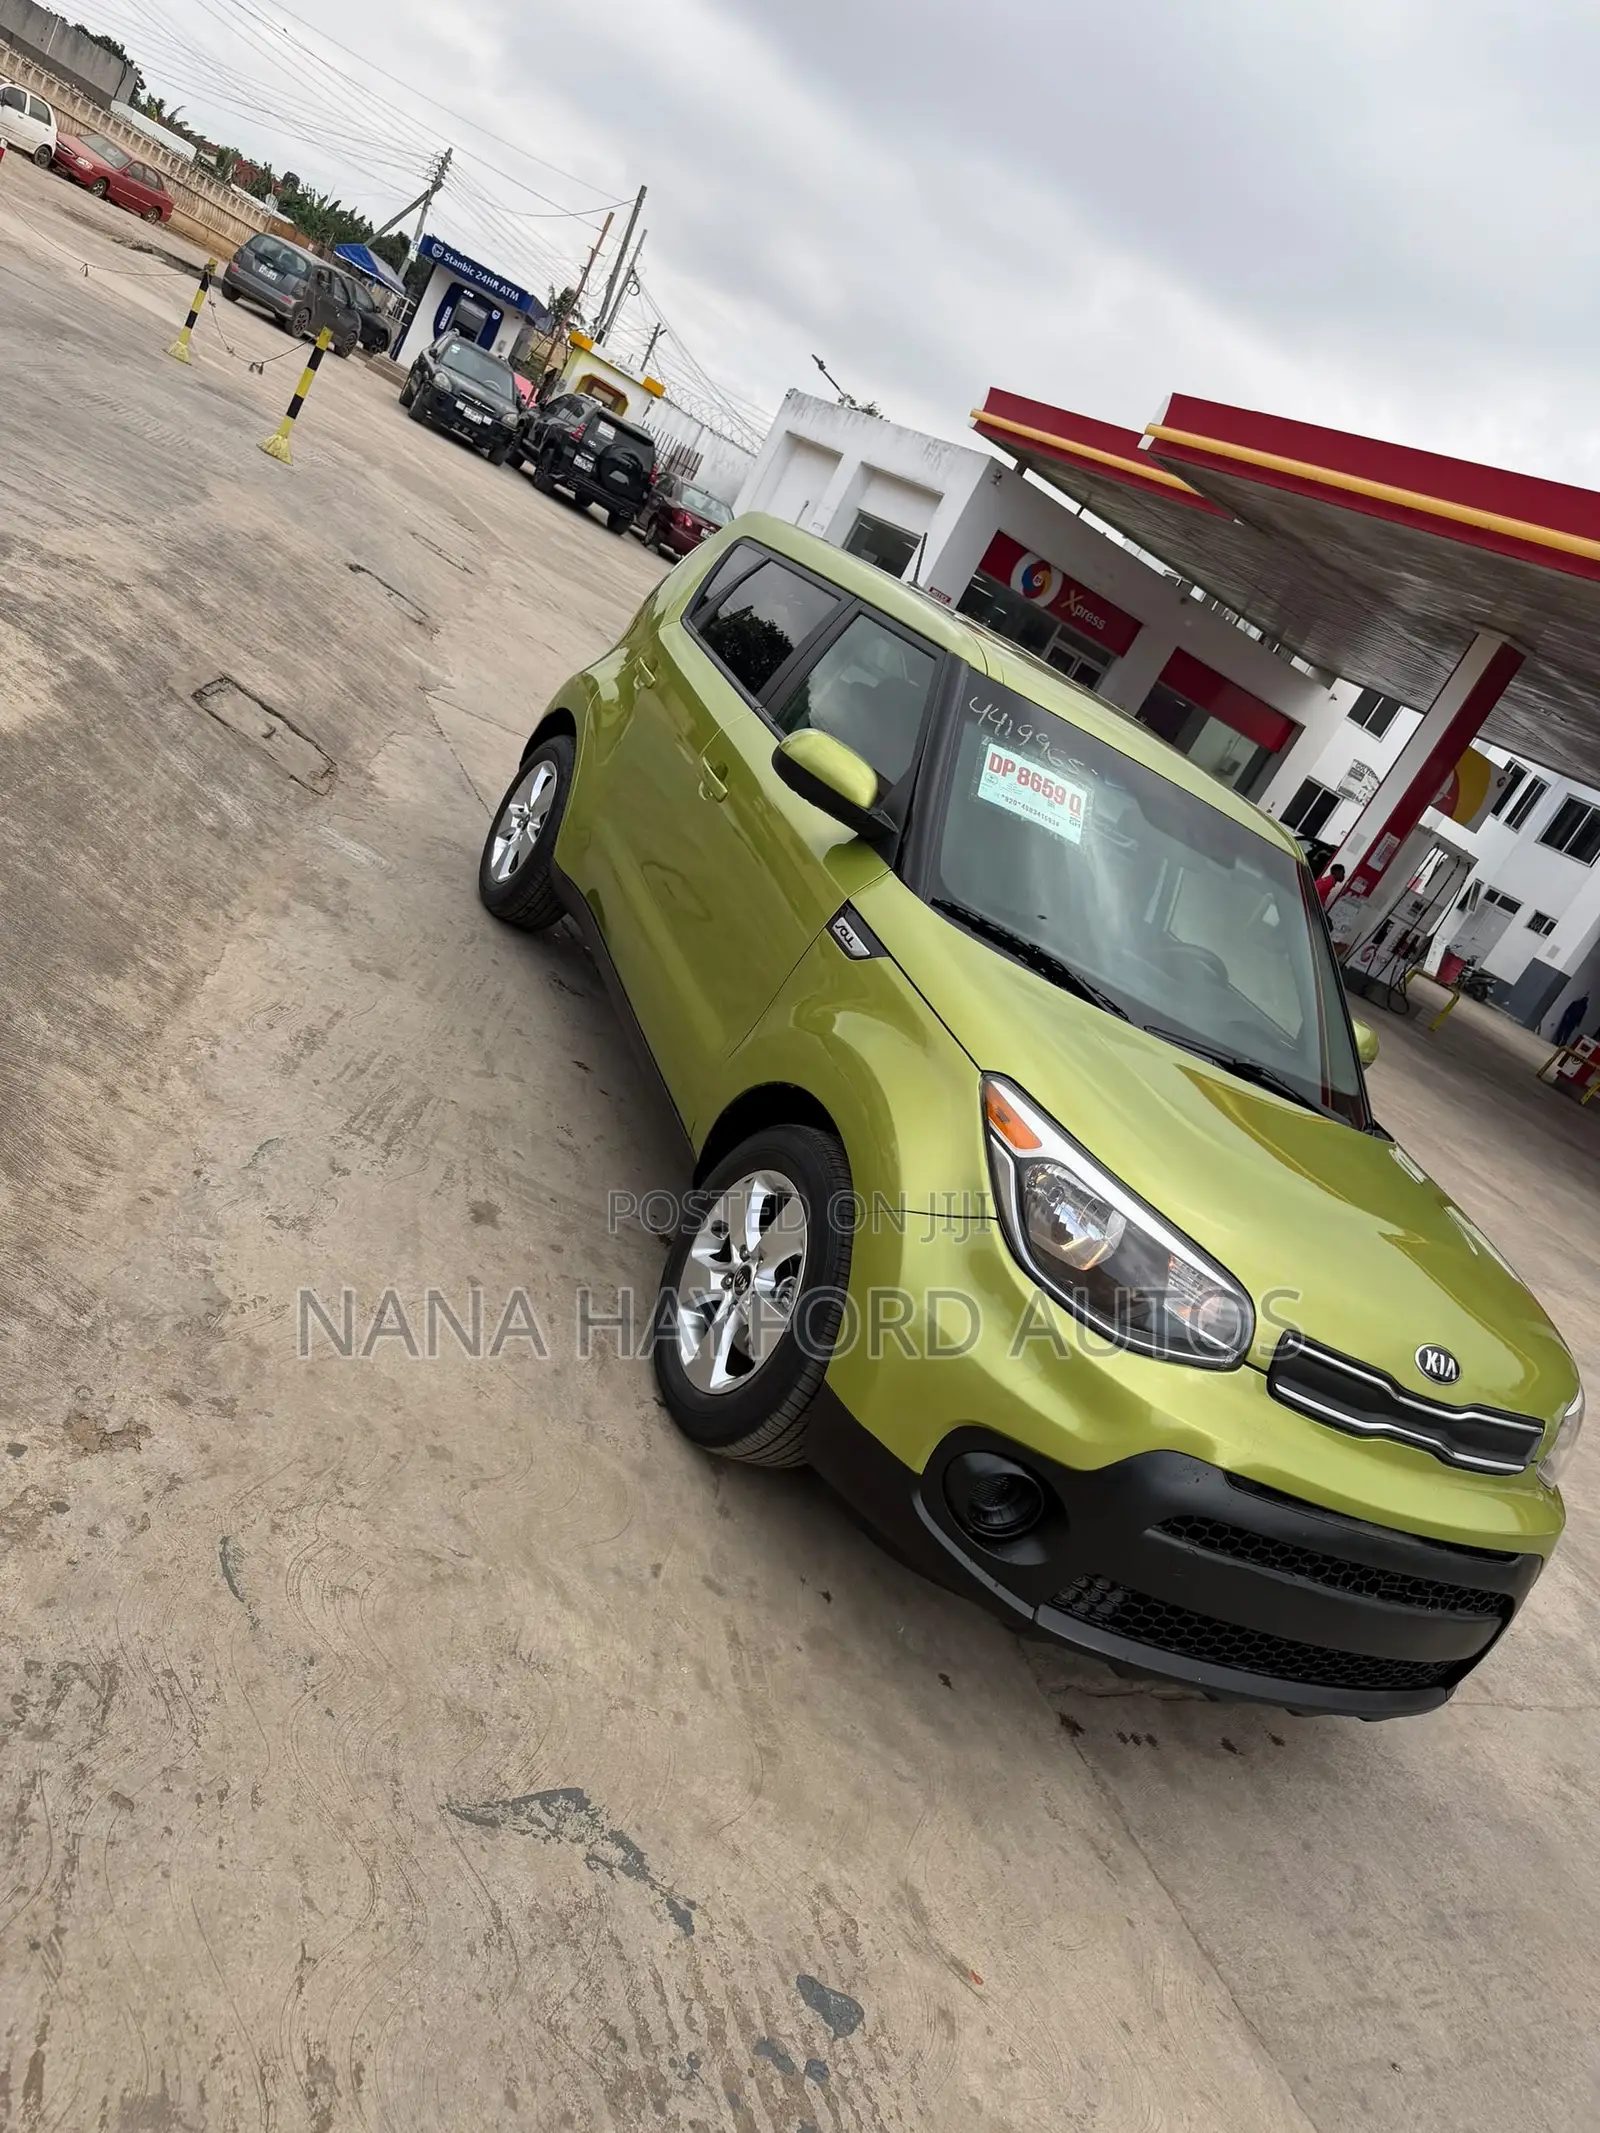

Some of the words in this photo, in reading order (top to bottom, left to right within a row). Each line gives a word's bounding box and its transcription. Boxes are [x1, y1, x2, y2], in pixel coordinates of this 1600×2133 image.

[444, 253, 475, 276] Stanbic
[475, 270, 499, 290] 24HR
[500, 285, 520, 302] ATM
[1060, 589, 1107, 631] Xpress
[988, 752, 1016, 777] DP
[1017, 767, 1067, 806] 8659
[835, 925, 854, 948] SOUL
[736, 1270, 748, 1290] KIA
[1425, 1350, 1457, 1379] KIA
